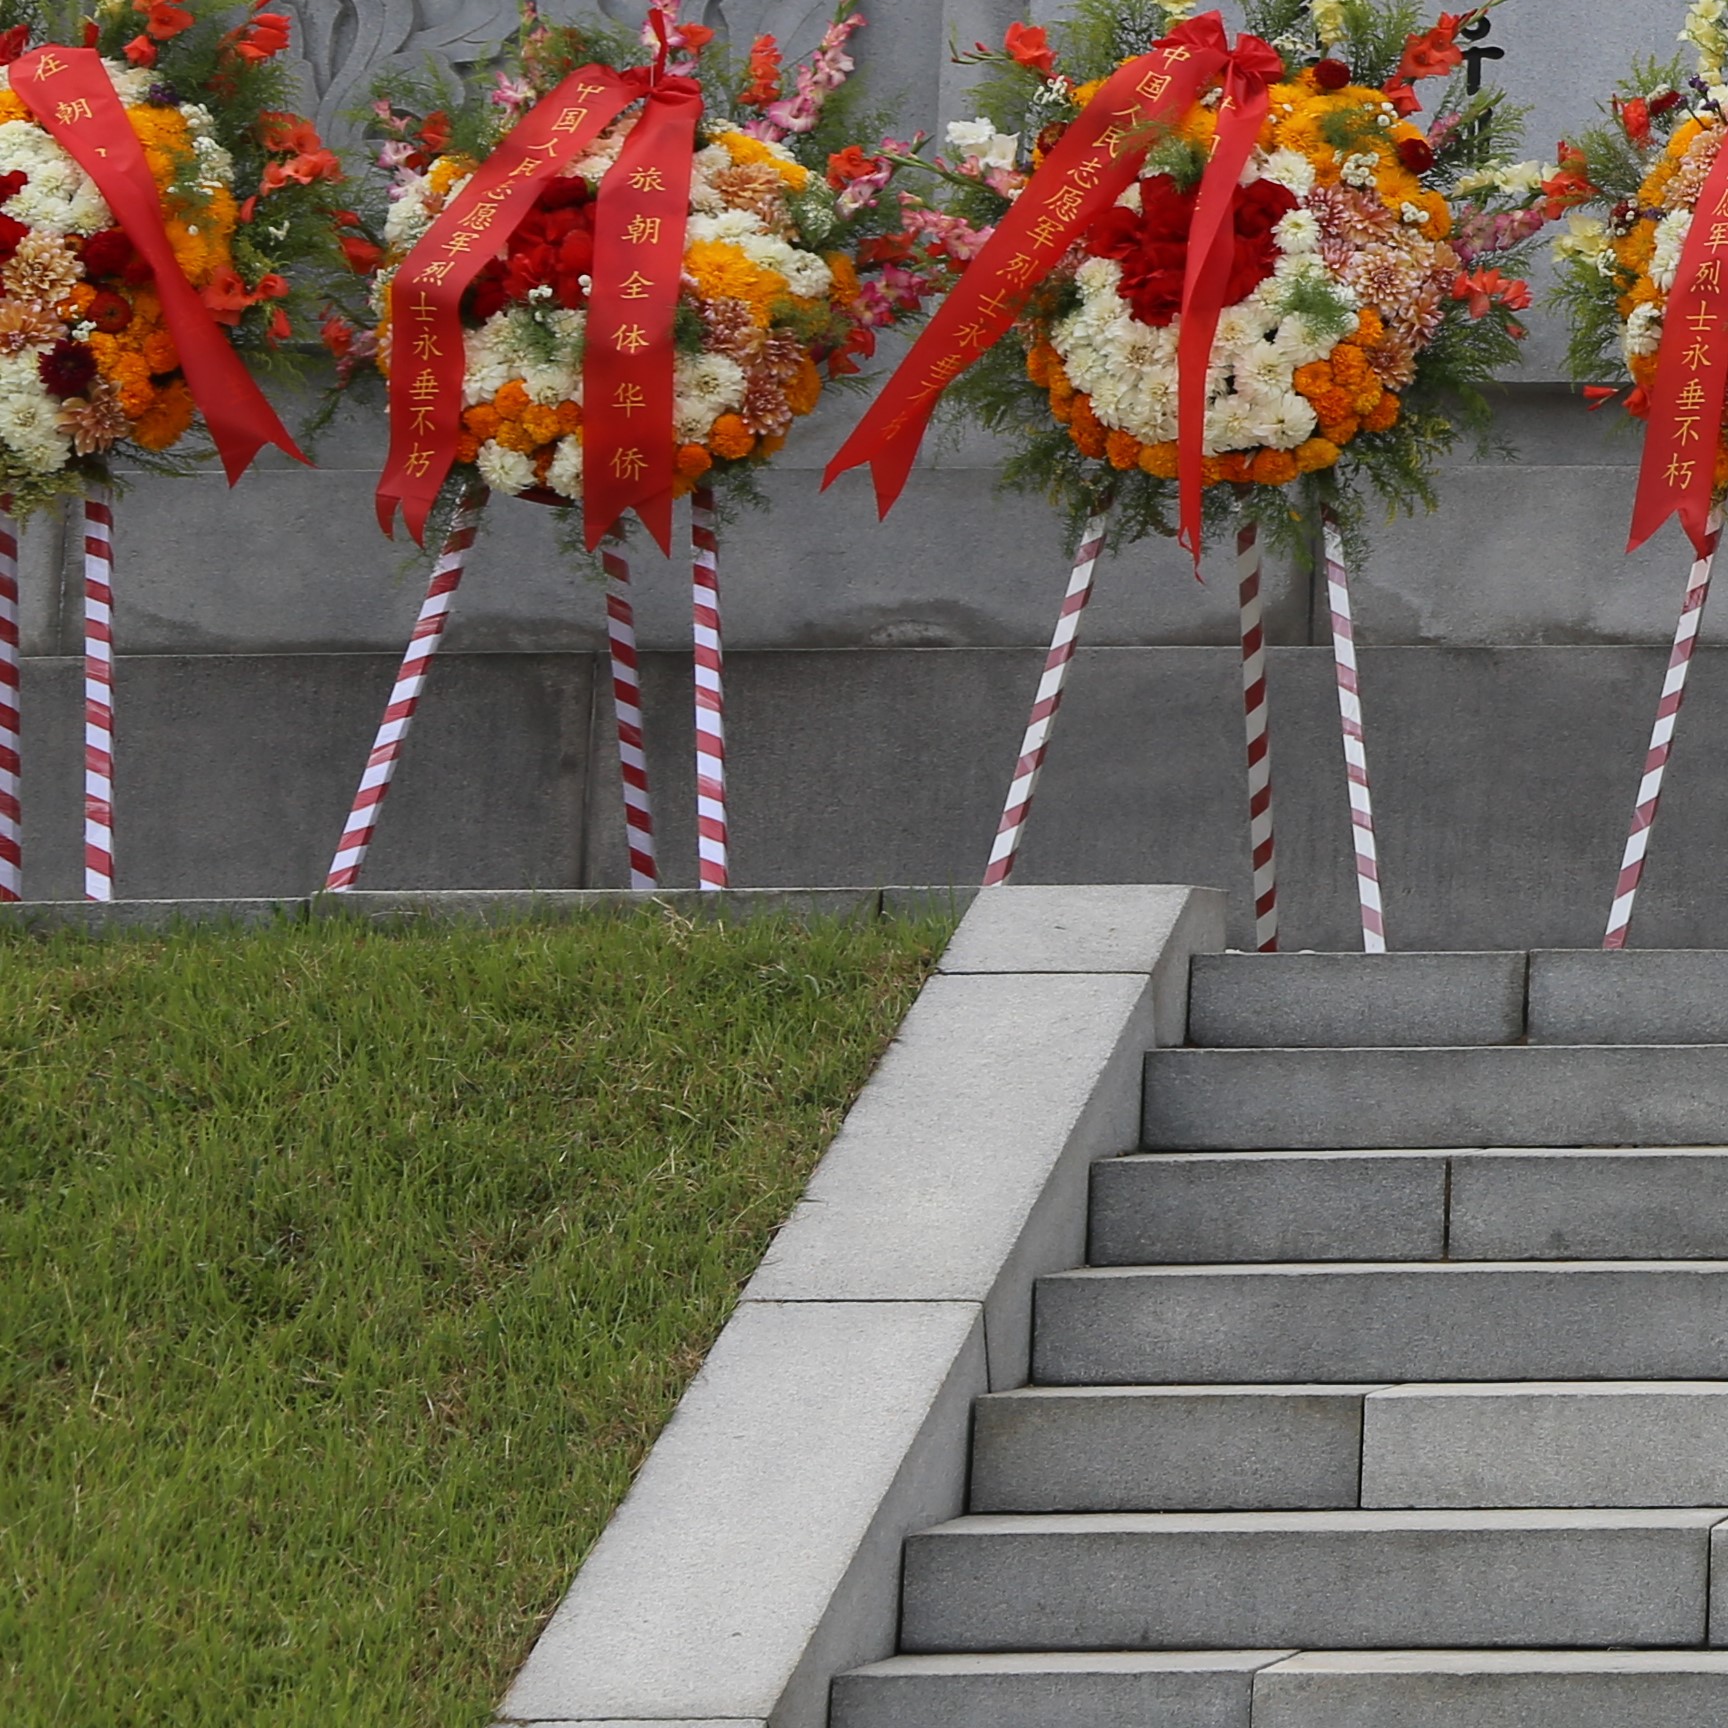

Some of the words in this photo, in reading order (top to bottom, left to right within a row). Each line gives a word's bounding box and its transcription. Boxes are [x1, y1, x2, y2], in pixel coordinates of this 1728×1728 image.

[609, 165, 666, 482] 旅朝全体华侨
